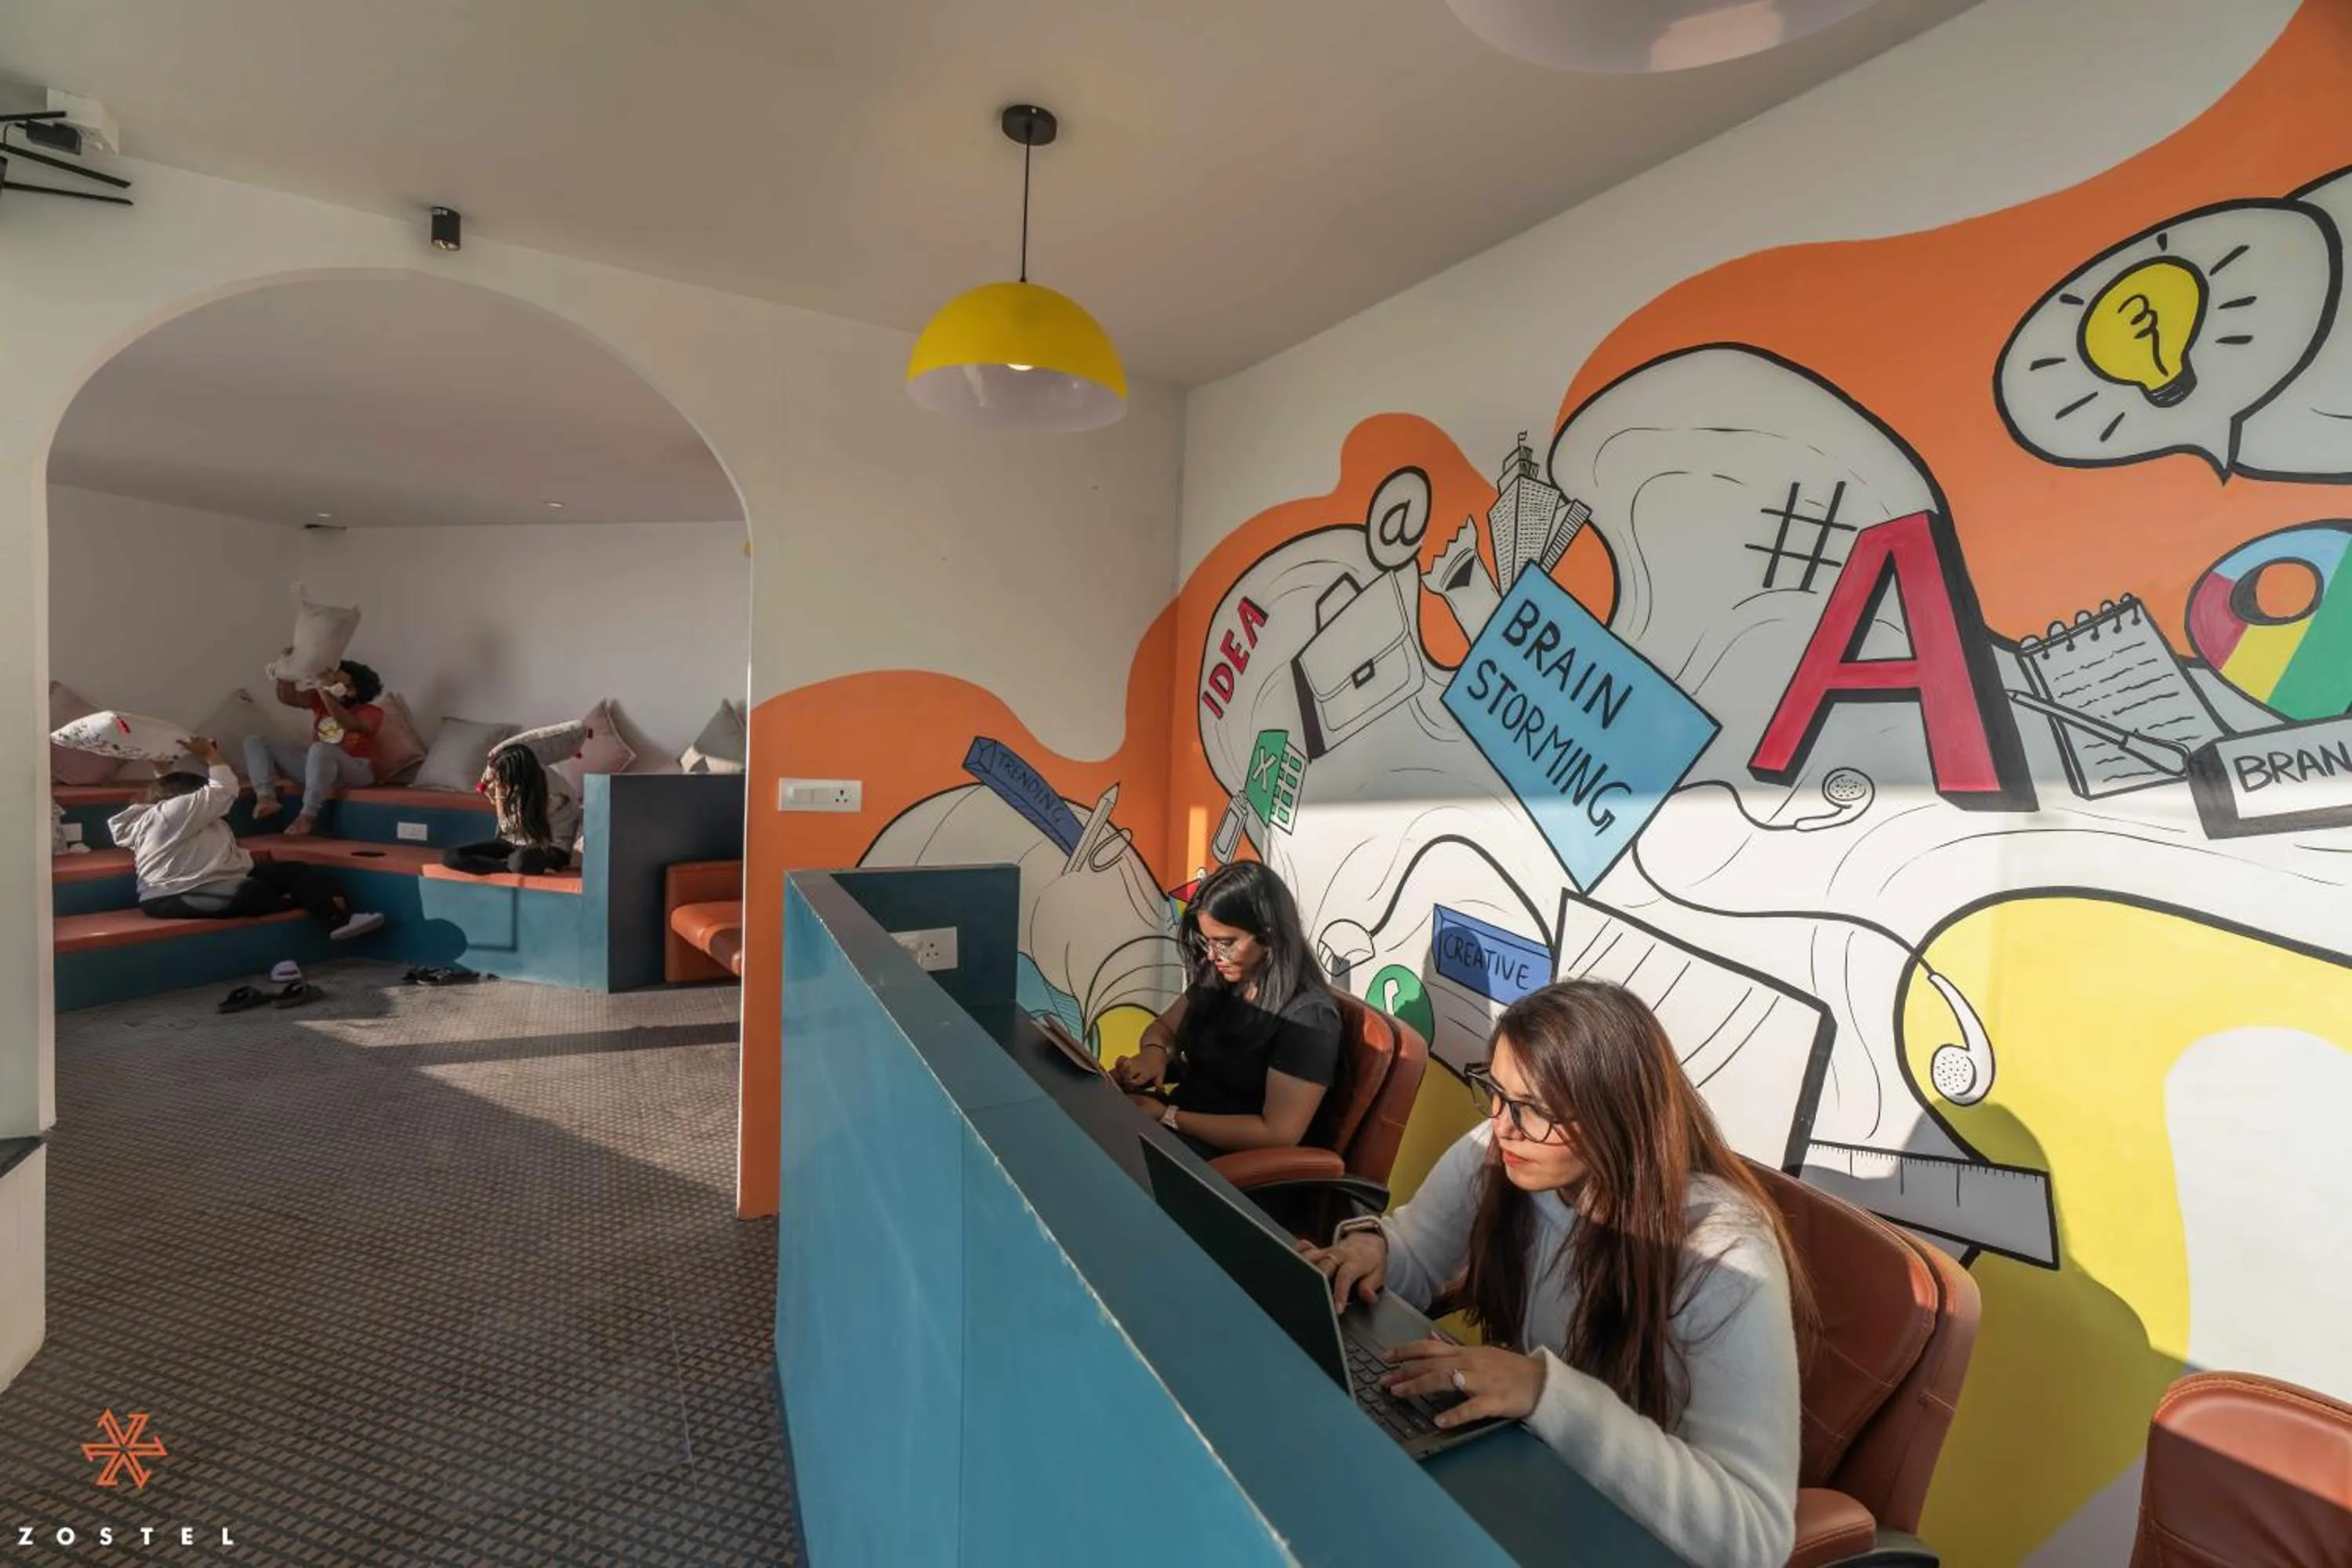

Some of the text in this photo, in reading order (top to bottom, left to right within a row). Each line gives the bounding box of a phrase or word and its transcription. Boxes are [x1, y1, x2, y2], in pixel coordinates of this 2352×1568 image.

[1200, 595, 1270, 720] IDEA
[1502, 598, 1635, 731] BRAIN
[996, 750, 1065, 823] TRENDING
[1467, 659, 1632, 837] STORMING
[2234, 740, 2352, 793] BRAN
[1443, 933, 1530, 990] CREATIVE
